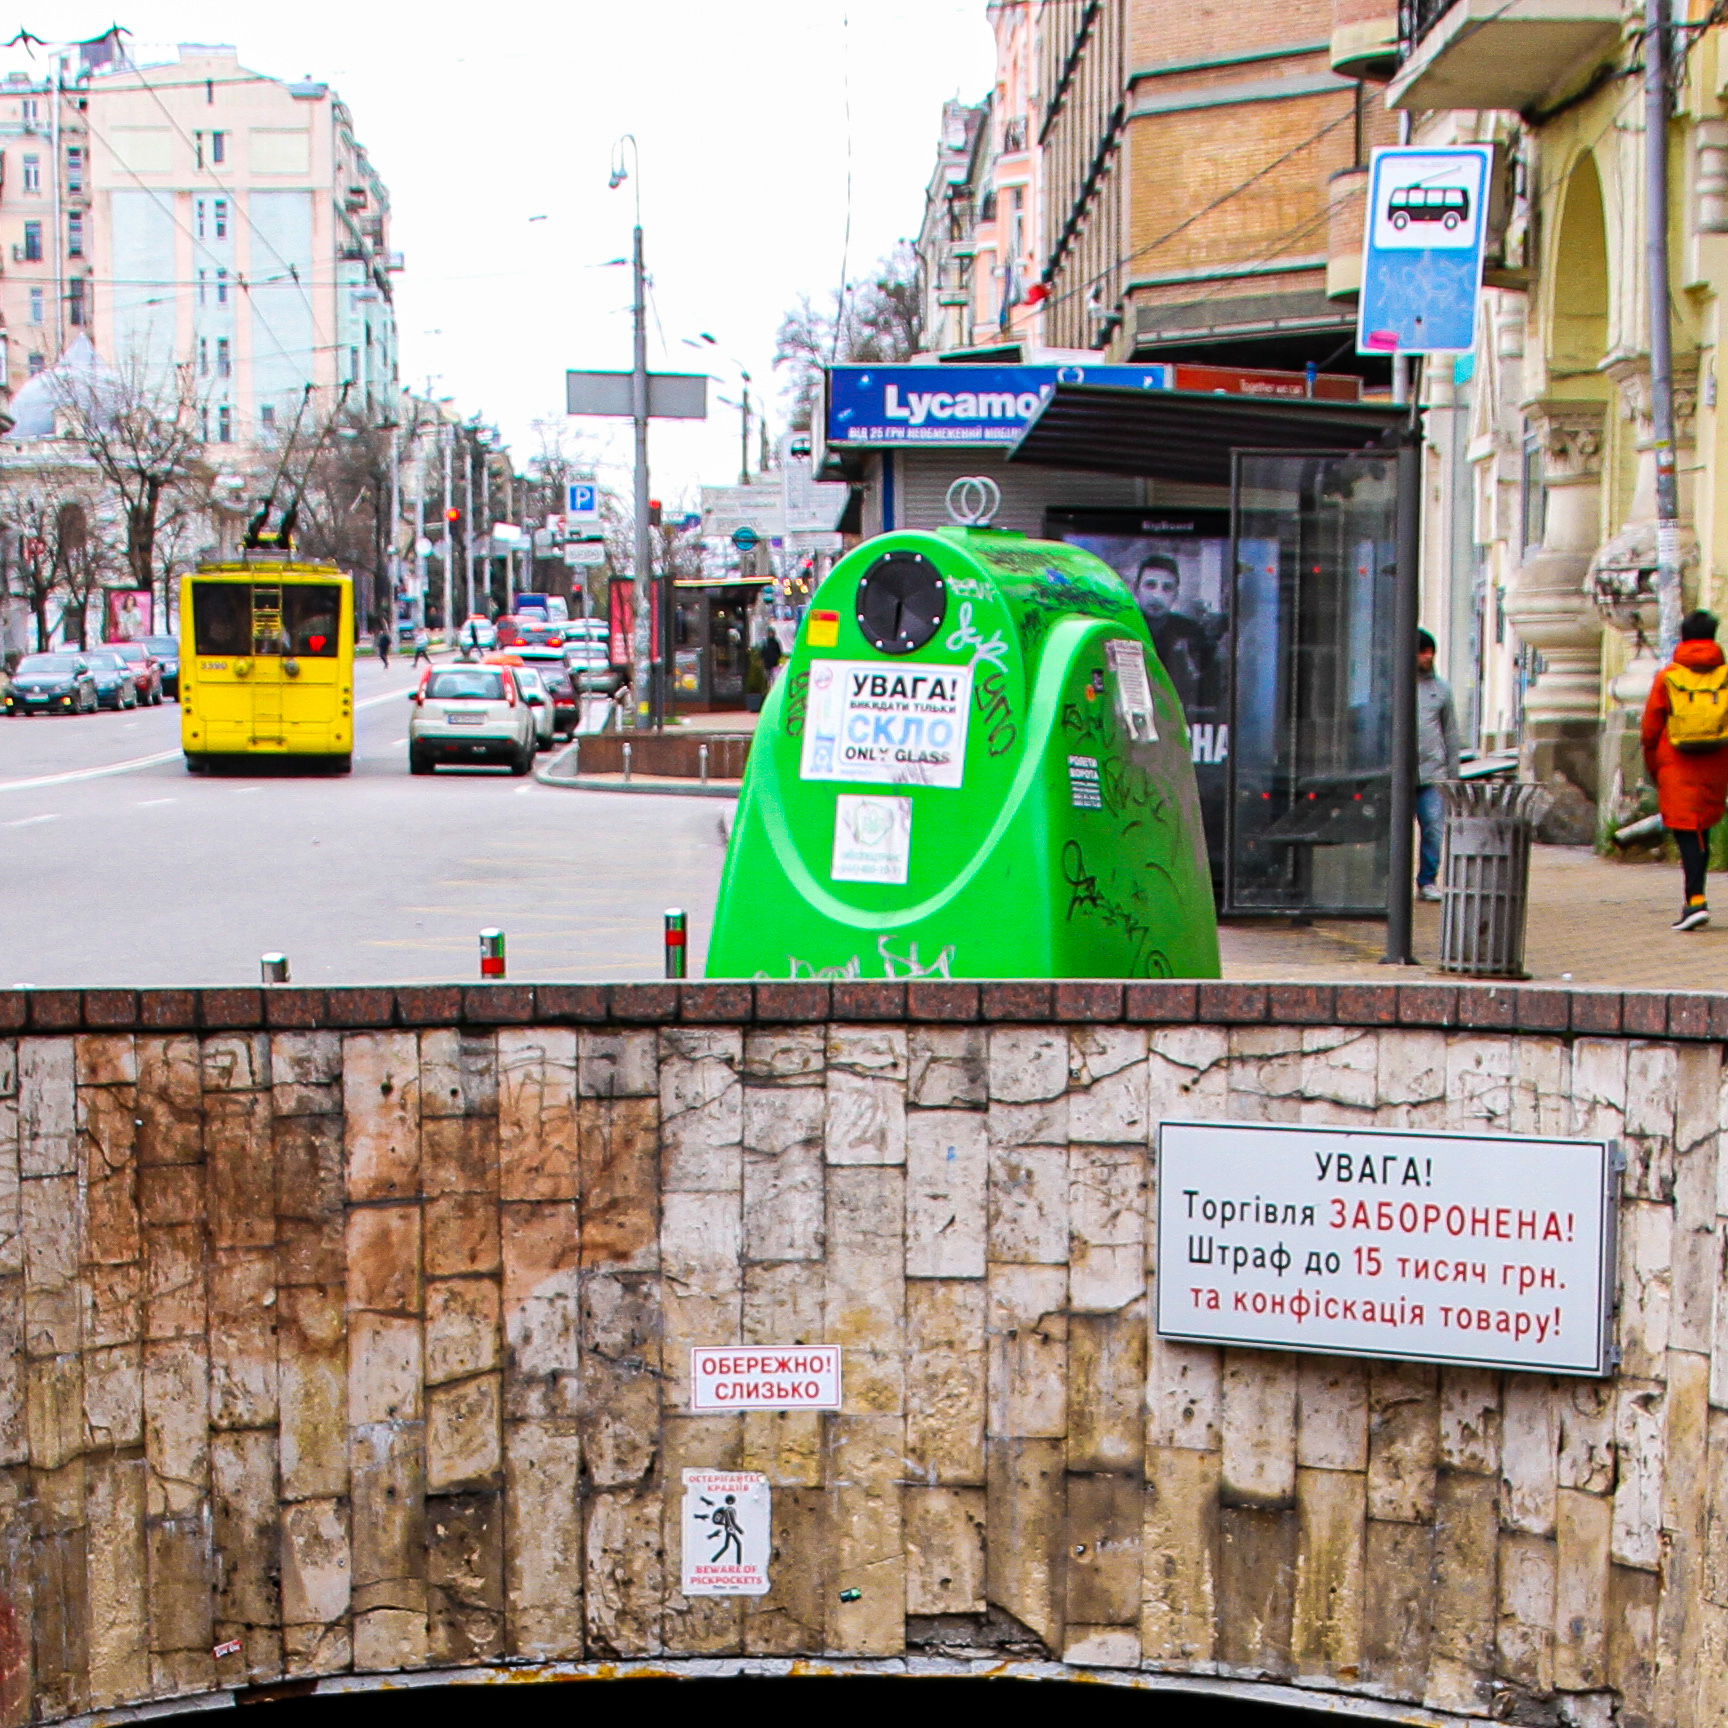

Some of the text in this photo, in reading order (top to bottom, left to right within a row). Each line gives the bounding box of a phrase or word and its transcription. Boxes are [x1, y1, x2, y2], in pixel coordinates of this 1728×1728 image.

[884, 383, 1050, 426] Lycamo
[870, 426, 883, 439] 25
[575, 486, 591, 509] P
[853, 673, 958, 701] УВАГА!
[850, 699, 957, 713] ВИКИДАТИ ТІЛЬКИ
[848, 713, 954, 748] СКЛО
[894, 747, 951, 765] GLASS
[1315, 1151, 1433, 1188] УВАГА!
[1182, 1189, 1576, 1242] Торгівля ЗАБОРОНЕНА!
[1188, 1234, 1567, 1295] Штраф до 15 тисяч грн.
[1190, 1287, 1562, 1344] та конфіскація товару!
[702, 1356, 832, 1376] ОБЕРЕЖНО!
[715, 1381, 820, 1401] СЛИЗЬКО
[689, 1474, 760, 1483] ОСТЕРІГАЙТЕС
[696, 1564, 757, 1574] BEWARE OF
[690, 1576, 763, 1585] PICKPOCKETS
